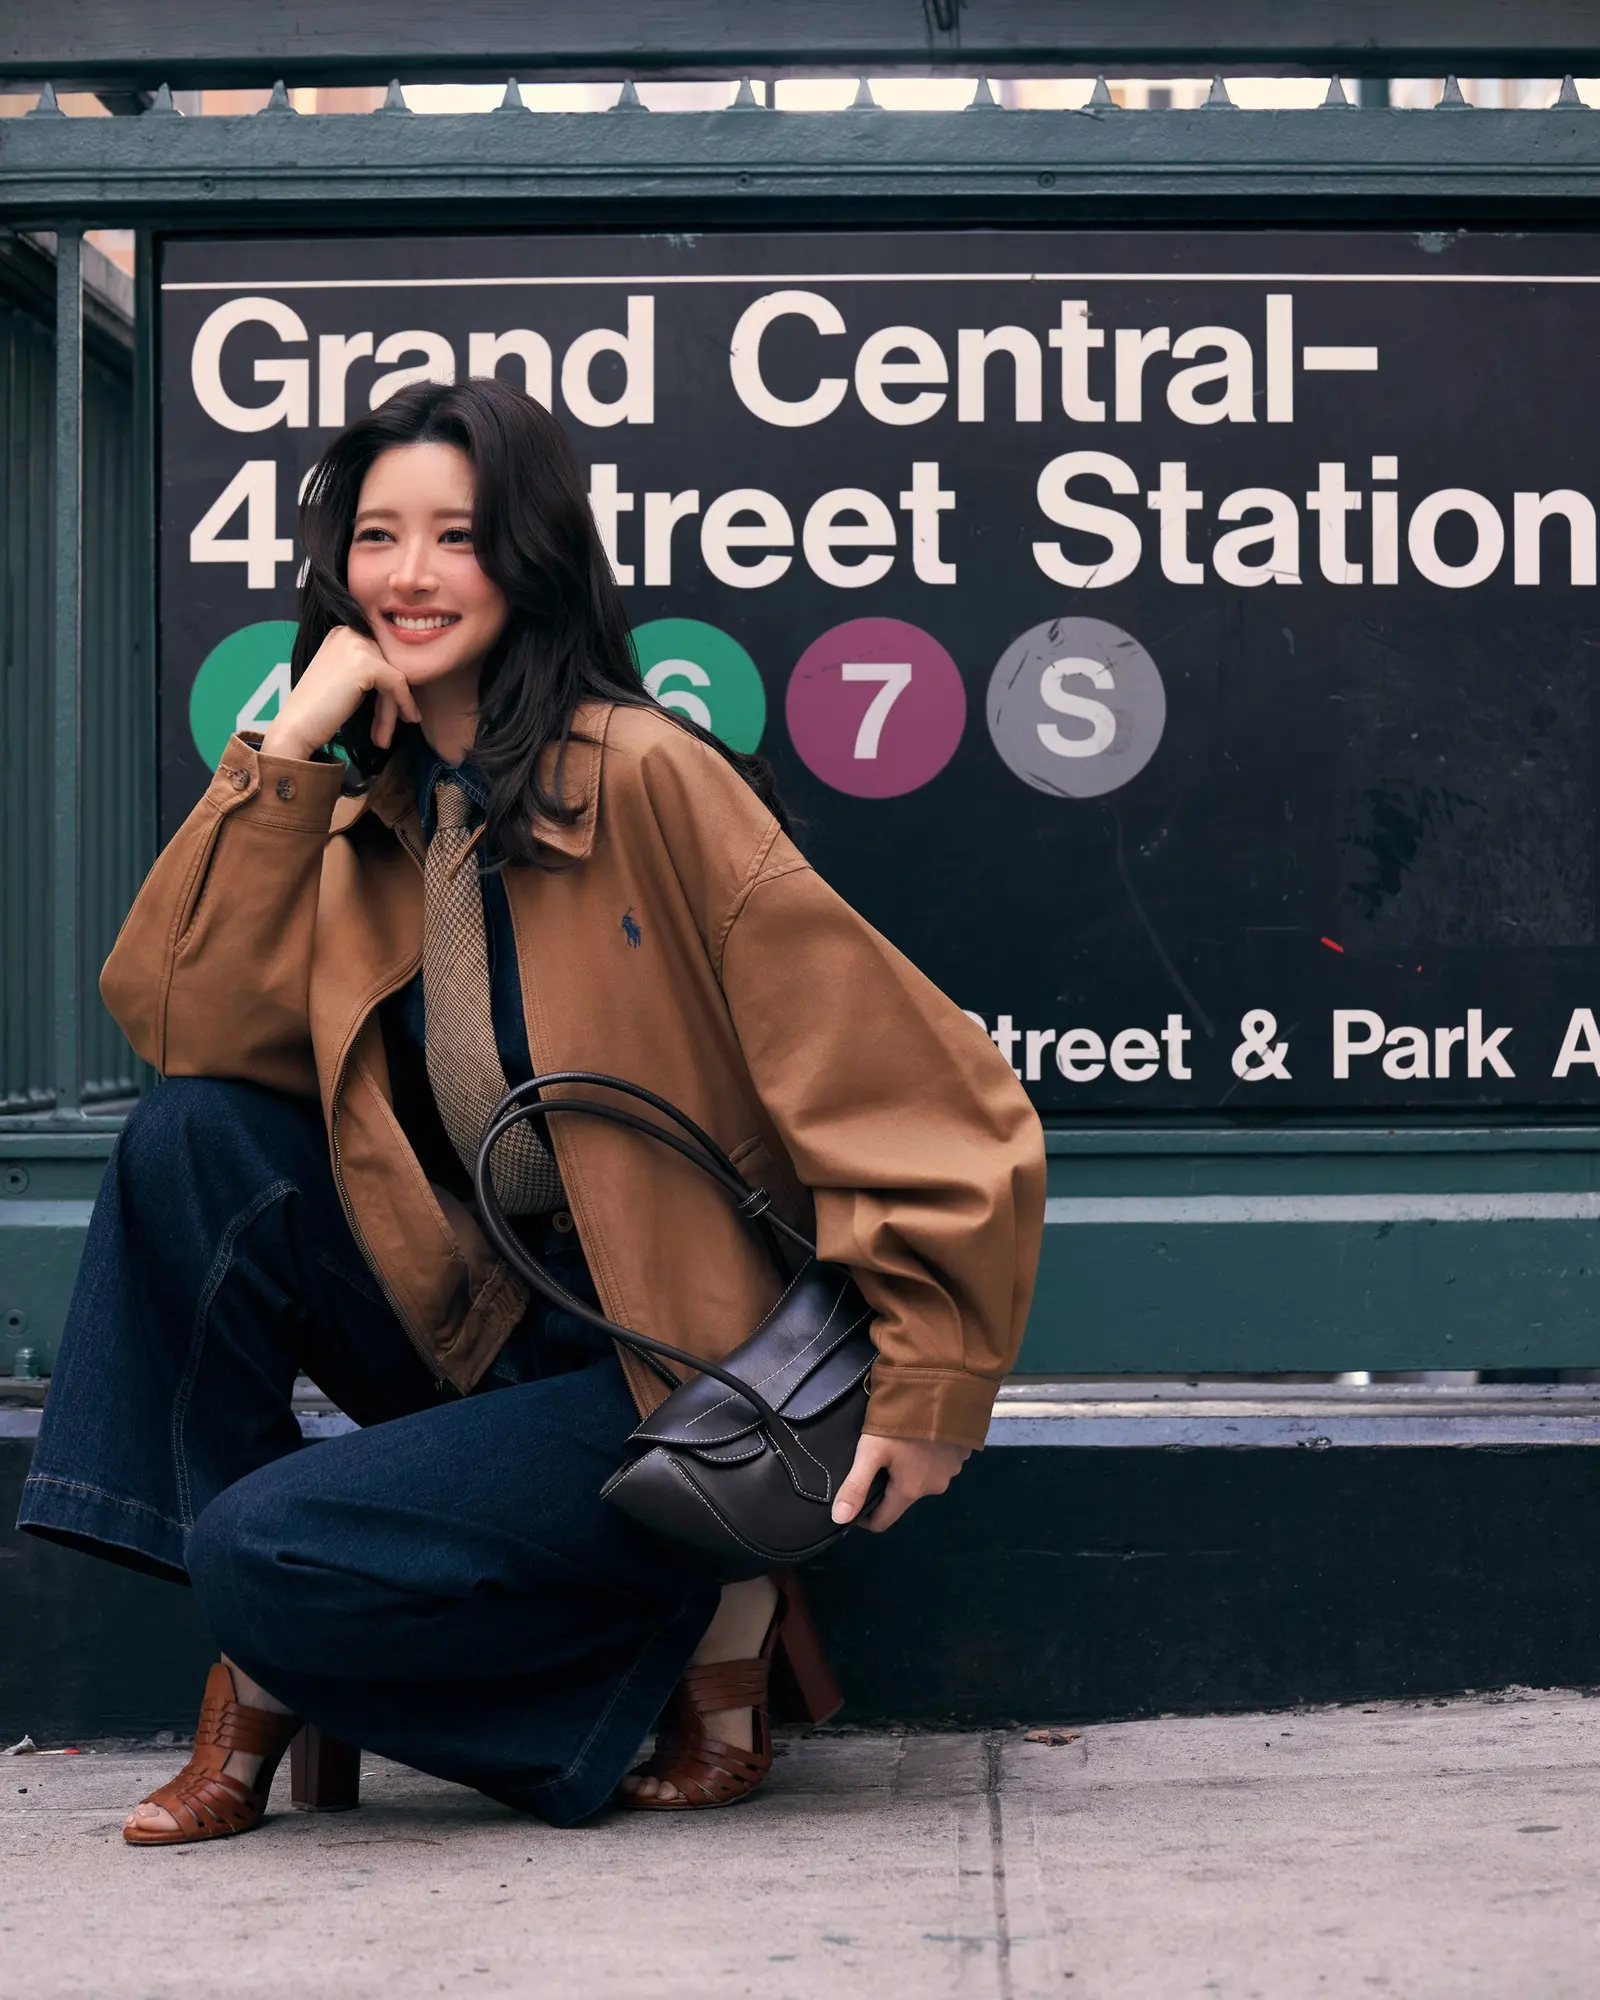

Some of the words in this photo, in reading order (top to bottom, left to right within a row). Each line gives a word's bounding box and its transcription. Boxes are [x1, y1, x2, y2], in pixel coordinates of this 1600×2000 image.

[192, 295, 655, 432] Grand
[190, 460, 336, 588] 4
[586, 462, 957, 588] treet
[1032, 450, 1597, 588] Station
[642, 658, 712, 731] 6
[841, 663, 912, 759] 7
[1036, 656, 1117, 757] S
[961, 1009, 1192, 1082] treet
[1231, 1009, 1293, 1081] &
[1333, 1008, 1517, 1080] Park
